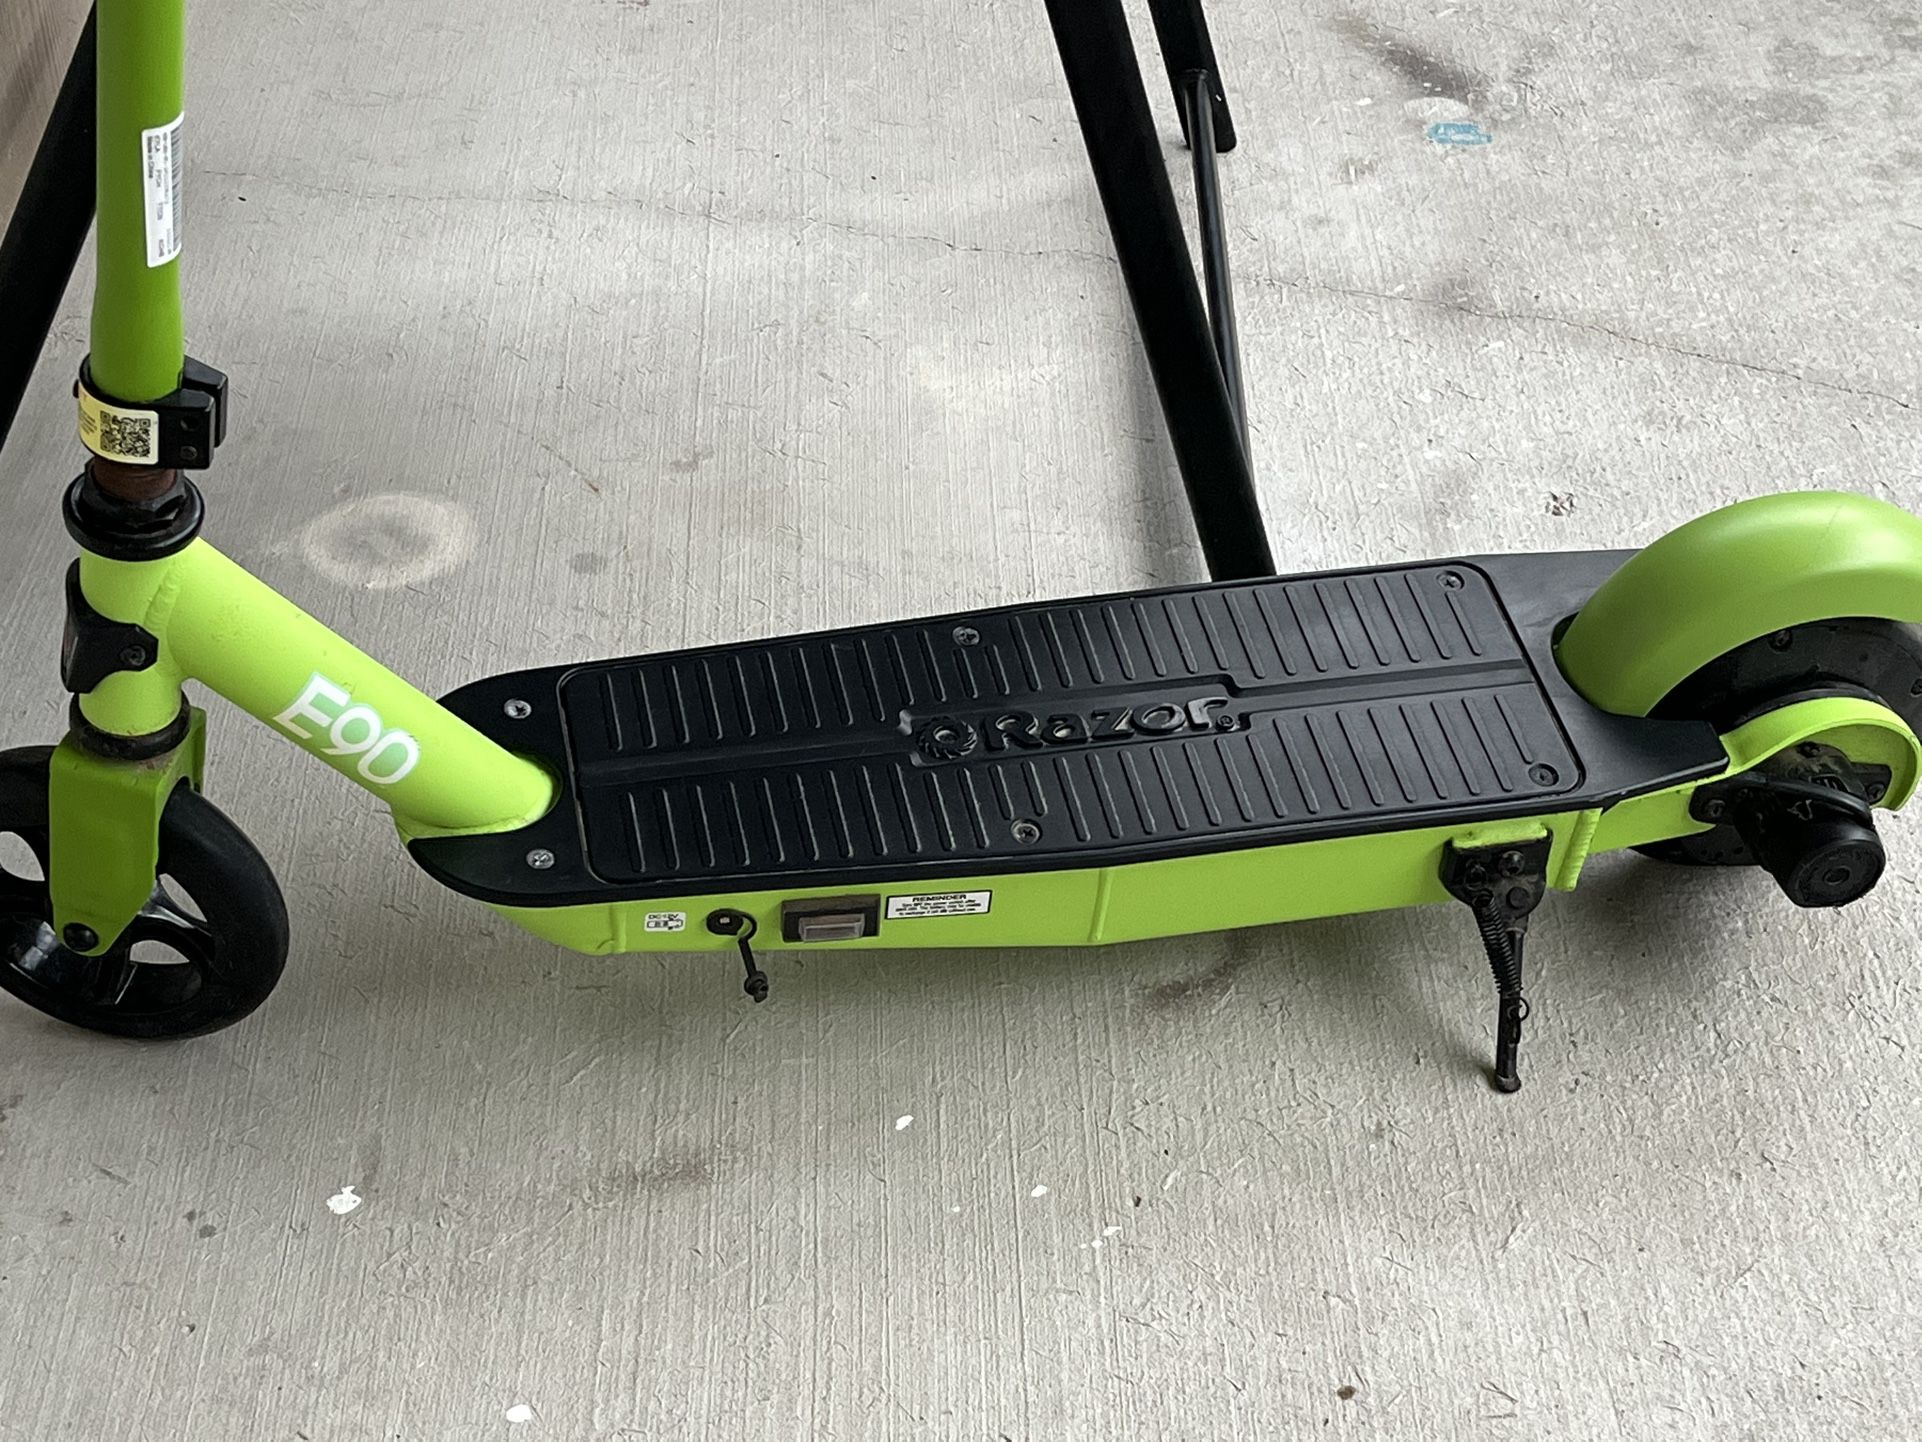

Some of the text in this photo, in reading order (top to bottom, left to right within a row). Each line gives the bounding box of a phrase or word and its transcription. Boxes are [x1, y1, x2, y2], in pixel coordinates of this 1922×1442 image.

[272, 671, 420, 785] E90
[983, 696, 1228, 752] Razor
[912, 894, 967, 902] REMINDER
